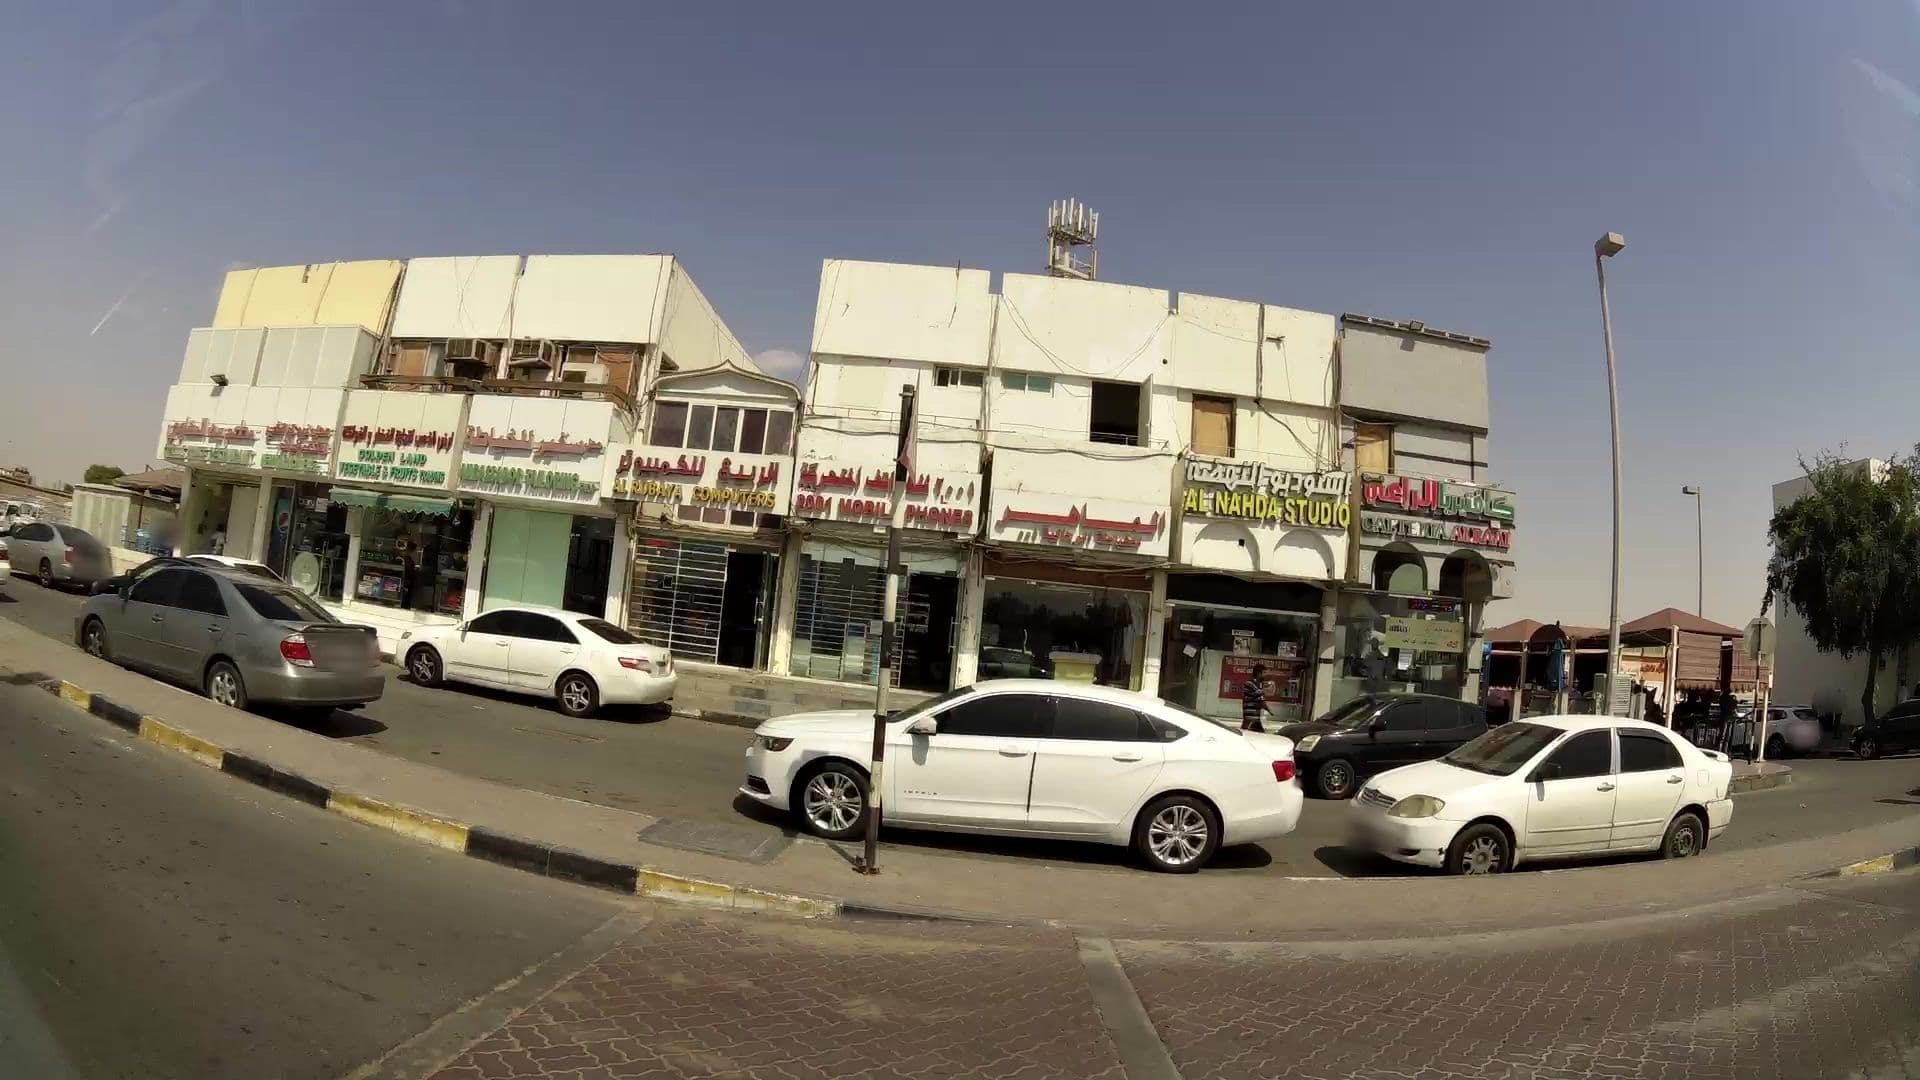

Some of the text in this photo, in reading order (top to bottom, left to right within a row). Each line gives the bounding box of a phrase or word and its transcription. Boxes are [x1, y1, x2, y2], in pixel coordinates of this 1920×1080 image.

[359, 449, 427, 466] GOLDEN LAND
[616, 449, 779, 484] الربيع للكمبيوتر
[339, 462, 382, 480] VEGETABLE
[390, 466, 418, 482] FRUITS
[613, 479, 628, 494] AL
[631, 480, 682, 500] RUBAYA
[693, 486, 776, 507] COMPUTERS
[904, 504, 973, 529] PHONES
[1185, 487, 1350, 528] AL NAHDA STUDIO
